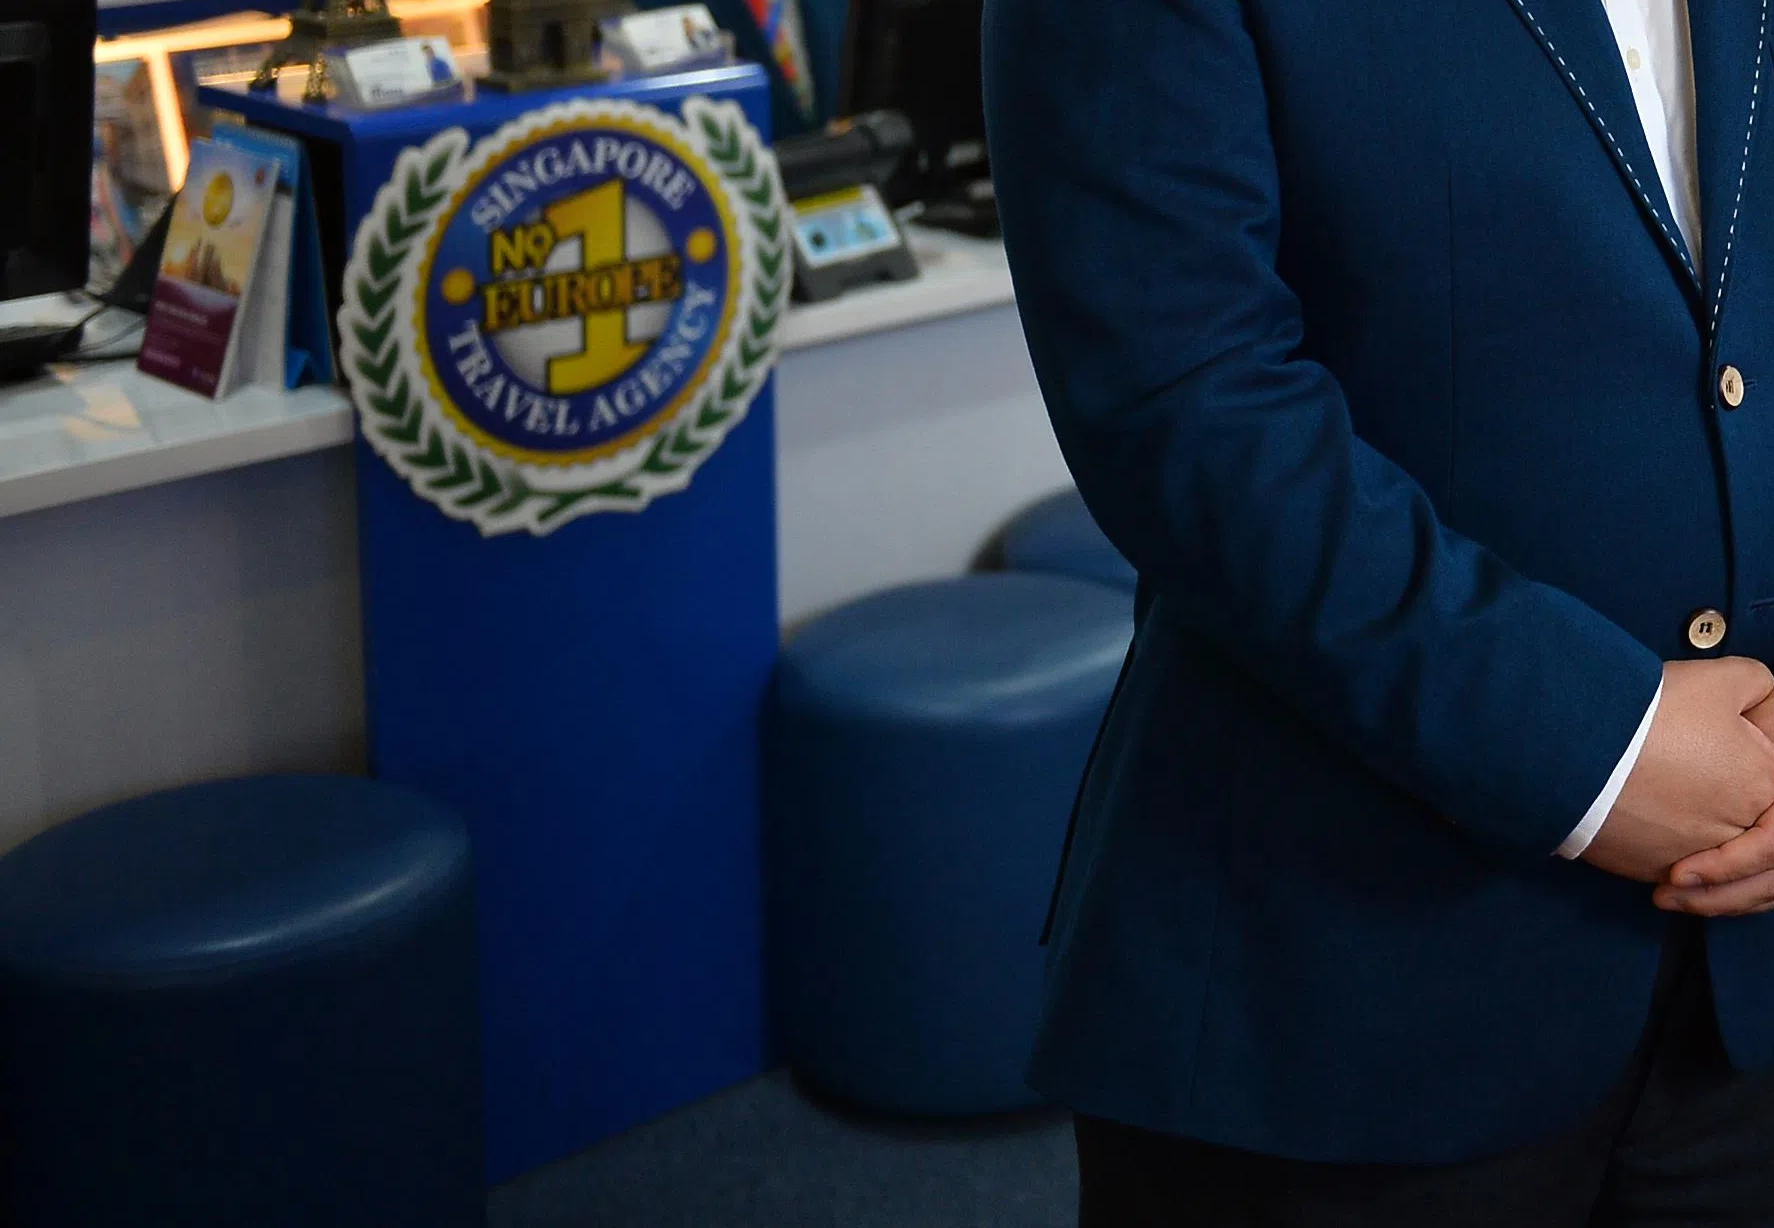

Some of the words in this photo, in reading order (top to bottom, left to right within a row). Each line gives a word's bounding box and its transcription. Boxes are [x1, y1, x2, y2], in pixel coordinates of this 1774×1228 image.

[471, 137, 697, 229] SINGAPORE
[481, 255, 682, 331] EUROPE
[545, 177, 656, 396] 1
[448, 320, 581, 436] TRAVEL
[588, 280, 717, 432] AGENCY
